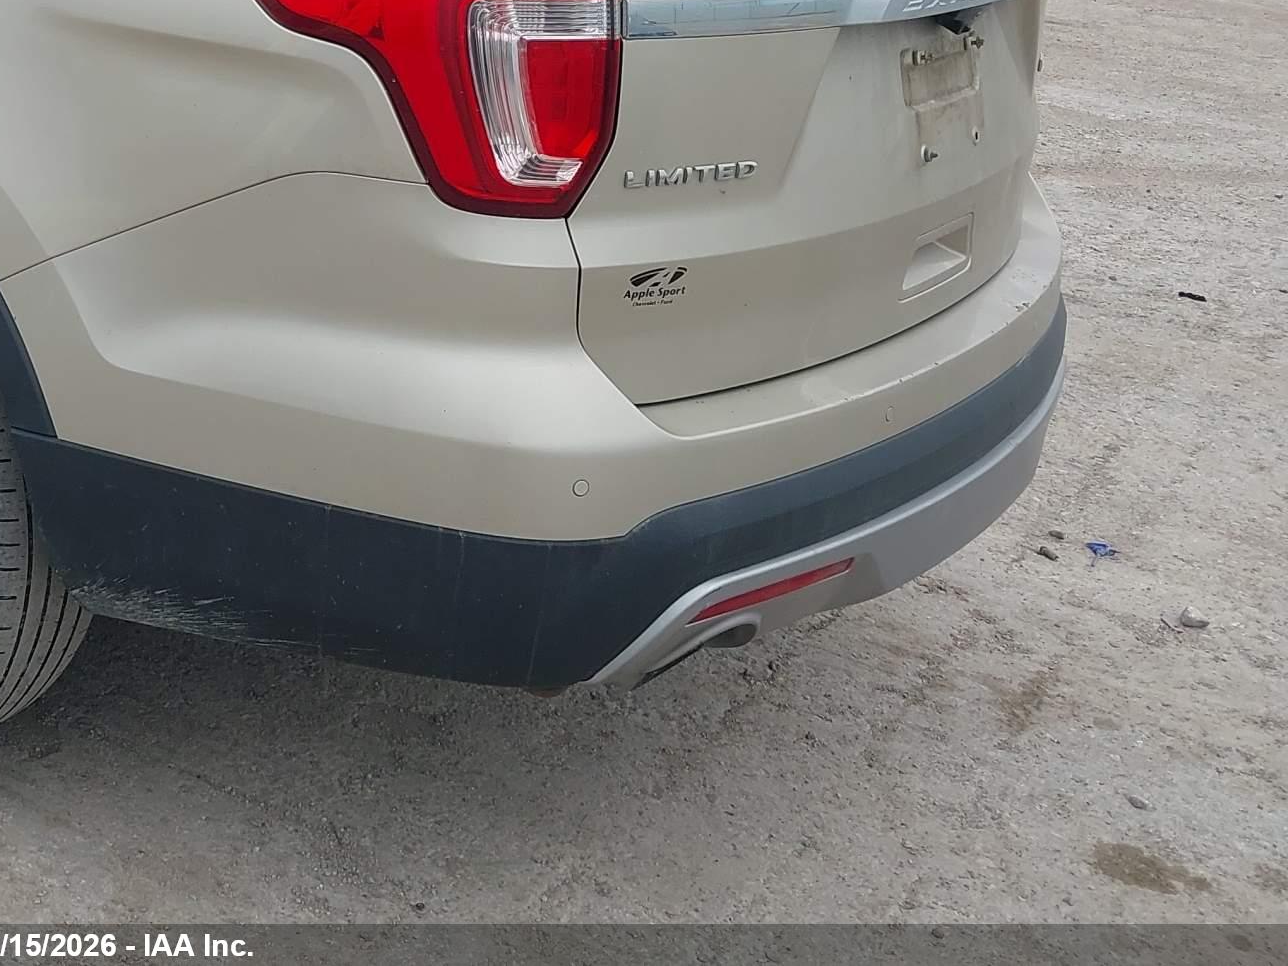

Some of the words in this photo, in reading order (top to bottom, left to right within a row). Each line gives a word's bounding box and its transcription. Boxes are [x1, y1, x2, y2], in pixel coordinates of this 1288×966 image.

[623, 160, 759, 189] LIMITED
[623, 287, 655, 301] Apple
[657, 286, 686, 298] Sport
